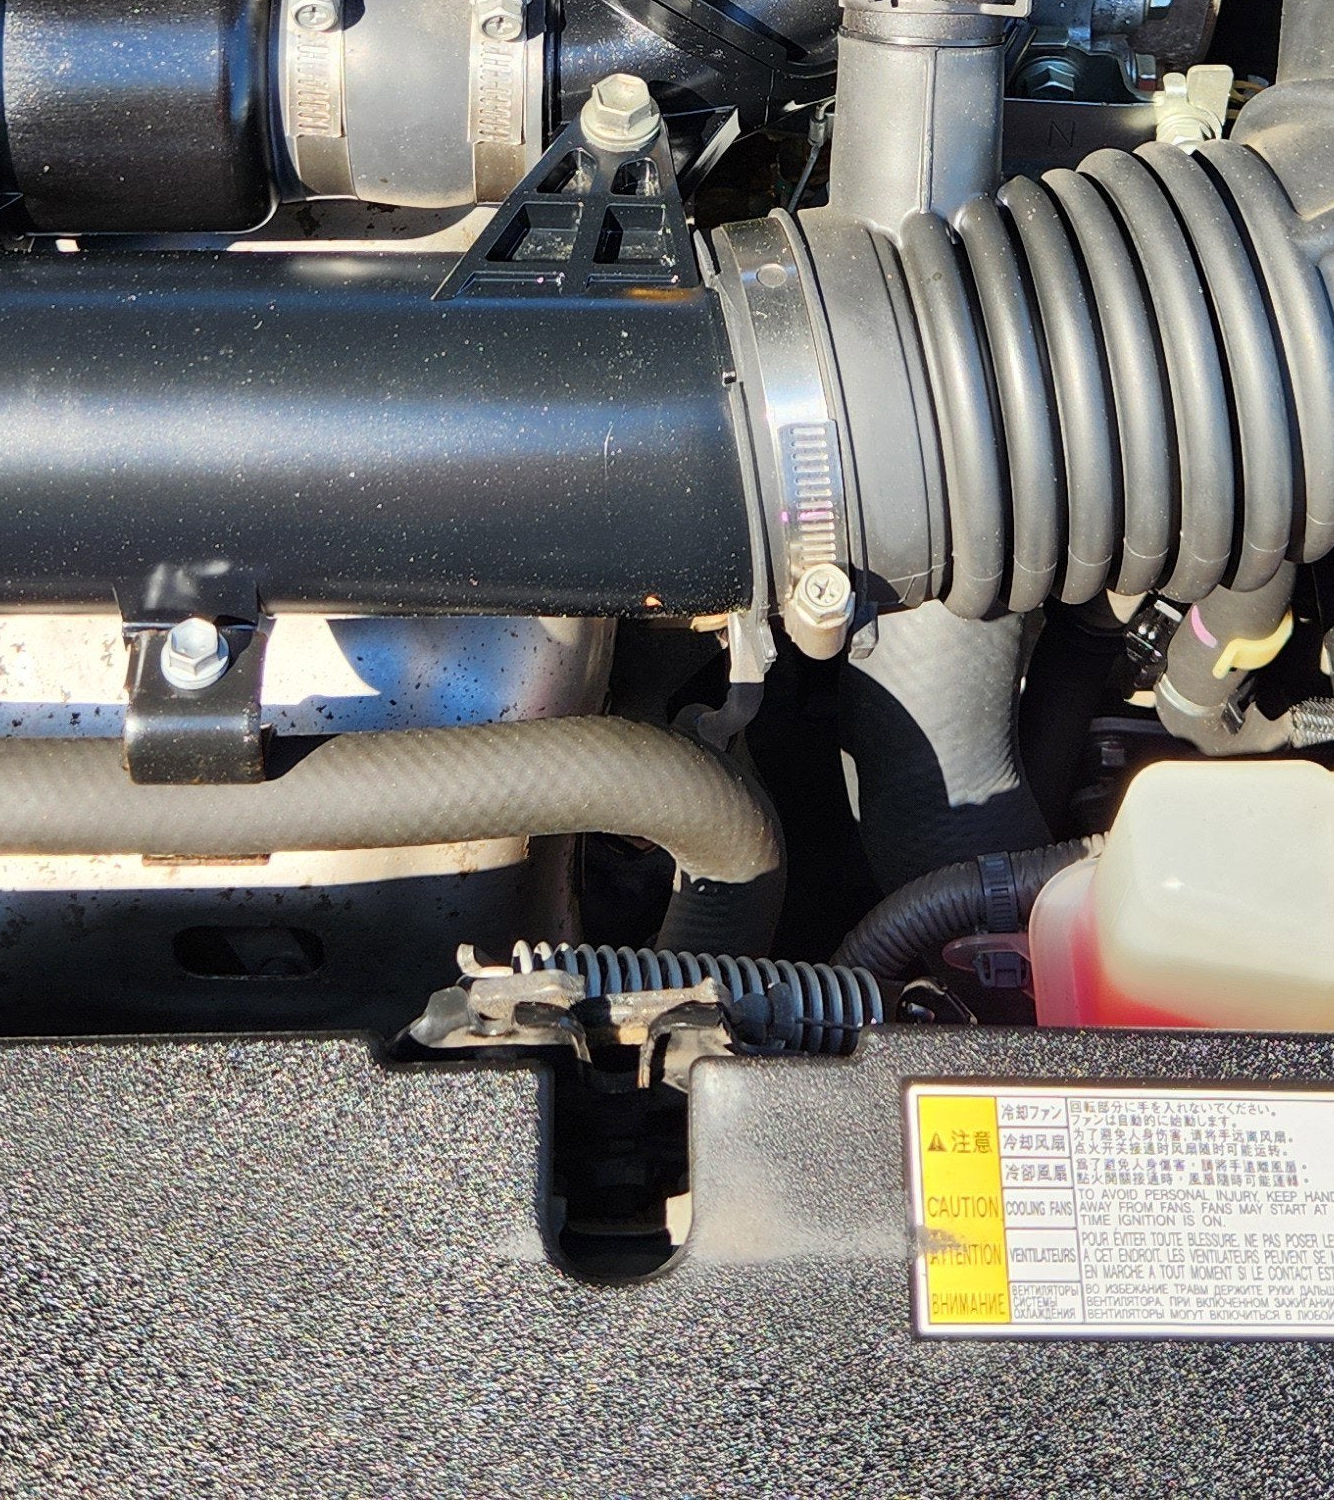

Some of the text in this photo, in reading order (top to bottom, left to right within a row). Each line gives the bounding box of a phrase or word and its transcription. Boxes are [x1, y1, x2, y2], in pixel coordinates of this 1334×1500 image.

[1000, 1105, 1061, 1121] 冷却ファン
[951, 1128, 992, 1153] 注意
[1002, 1133, 1065, 1151] 冷却风扇
[1077, 1188, 1094, 1199] TO
[1101, 1188, 1138, 1200] AVOID
[1144, 1189, 1209, 1201] PERSONAL
[1266, 1190, 1297, 1202] KEEP
[926, 1195, 999, 1218] CAUTION
[1005, 1200, 1072, 1215] COOLING FANS
[1078, 1201, 1111, 1212] AWAY
[1118, 1201, 1152, 1213] FROM
[1160, 1202, 1195, 1213] FANS.
[1201, 1202, 1232, 1214] FANS
[1238, 1202, 1263, 1214] MAY
[1270, 1203, 1307, 1214] START
[1313, 1203, 1328, 1215] AT
[1080, 1213, 1225, 1227] TIME IGNITION IS ON.
[1081, 1231, 1108, 1246] POUR
[1112, 1227, 1146, 1246] ÉVITER
[1150, 1231, 1183, 1246] TOUTE
[1244, 1232, 1258, 1248] NE
[1262, 1232, 1281, 1248] PAS
[1285, 1233, 1318, 1248] POSER
[1009, 1248, 1076, 1262] VENTILATEURS
[1082, 1247, 1090, 1262] A
[1094, 1247, 1114, 1262] CET
[1118, 1247, 1161, 1263] ENDROIT.
[1166, 1248, 1185, 1263] LES
[1189, 1248, 1260, 1264] VENTILATEURS
[1263, 1249, 1308, 1264] PEUVENT
[1312, 1249, 1326, 1264] SE
[1084, 1264, 1098, 1279] EN
[1102, 1264, 1144, 1279] MARCHE
[1147, 1264, 1155, 1279] A
[1159, 1264, 1186, 1279] TOUT
[1190, 1265, 1233, 1280] MOMENT
[1237, 1265, 1247, 1280] SI
[1251, 1265, 1264, 1280] LE
[1267, 1265, 1314, 1280] CONTACT
[1011, 1284, 1078, 1295] ВЕНТИЛЯТОРЫ
[1085, 1283, 1100, 1294] ВО
[1105, 1283, 1169, 1295] ИЗБЕЖАНИЕ
[1174, 1284, 1208, 1295] ТРАВМ
[1213, 1284, 1263, 1295] ДЕРЖИТЕ
[1268, 1285, 1294, 1295] РУКИ
[932, 1292, 1005, 1314] ВНИМАНИЕ
[1012, 1296, 1058, 1307] СИСТЕМЫ
[1086, 1296, 1163, 1307] ВЕНТИЛЯТОРА.
[1169, 1296, 1190, 1307] ПРИ
[1195, 1297, 1269, 1308] ВКЛЮЧЕННОМ
[1013, 1308, 1075, 1320] ОХЛАЖДЕНИЯ
[1087, 1308, 1164, 1320] ВЕНТИЛЯТОРЫ
[1170, 1308, 1204, 1320] МОГУТ
[1209, 1309, 1280, 1320] ВКЛЮЧИТЬСЯ
[1284, 1309, 1292, 1320] В
[1297, 1309, 1334, 1321] ЛЮБОЙ
